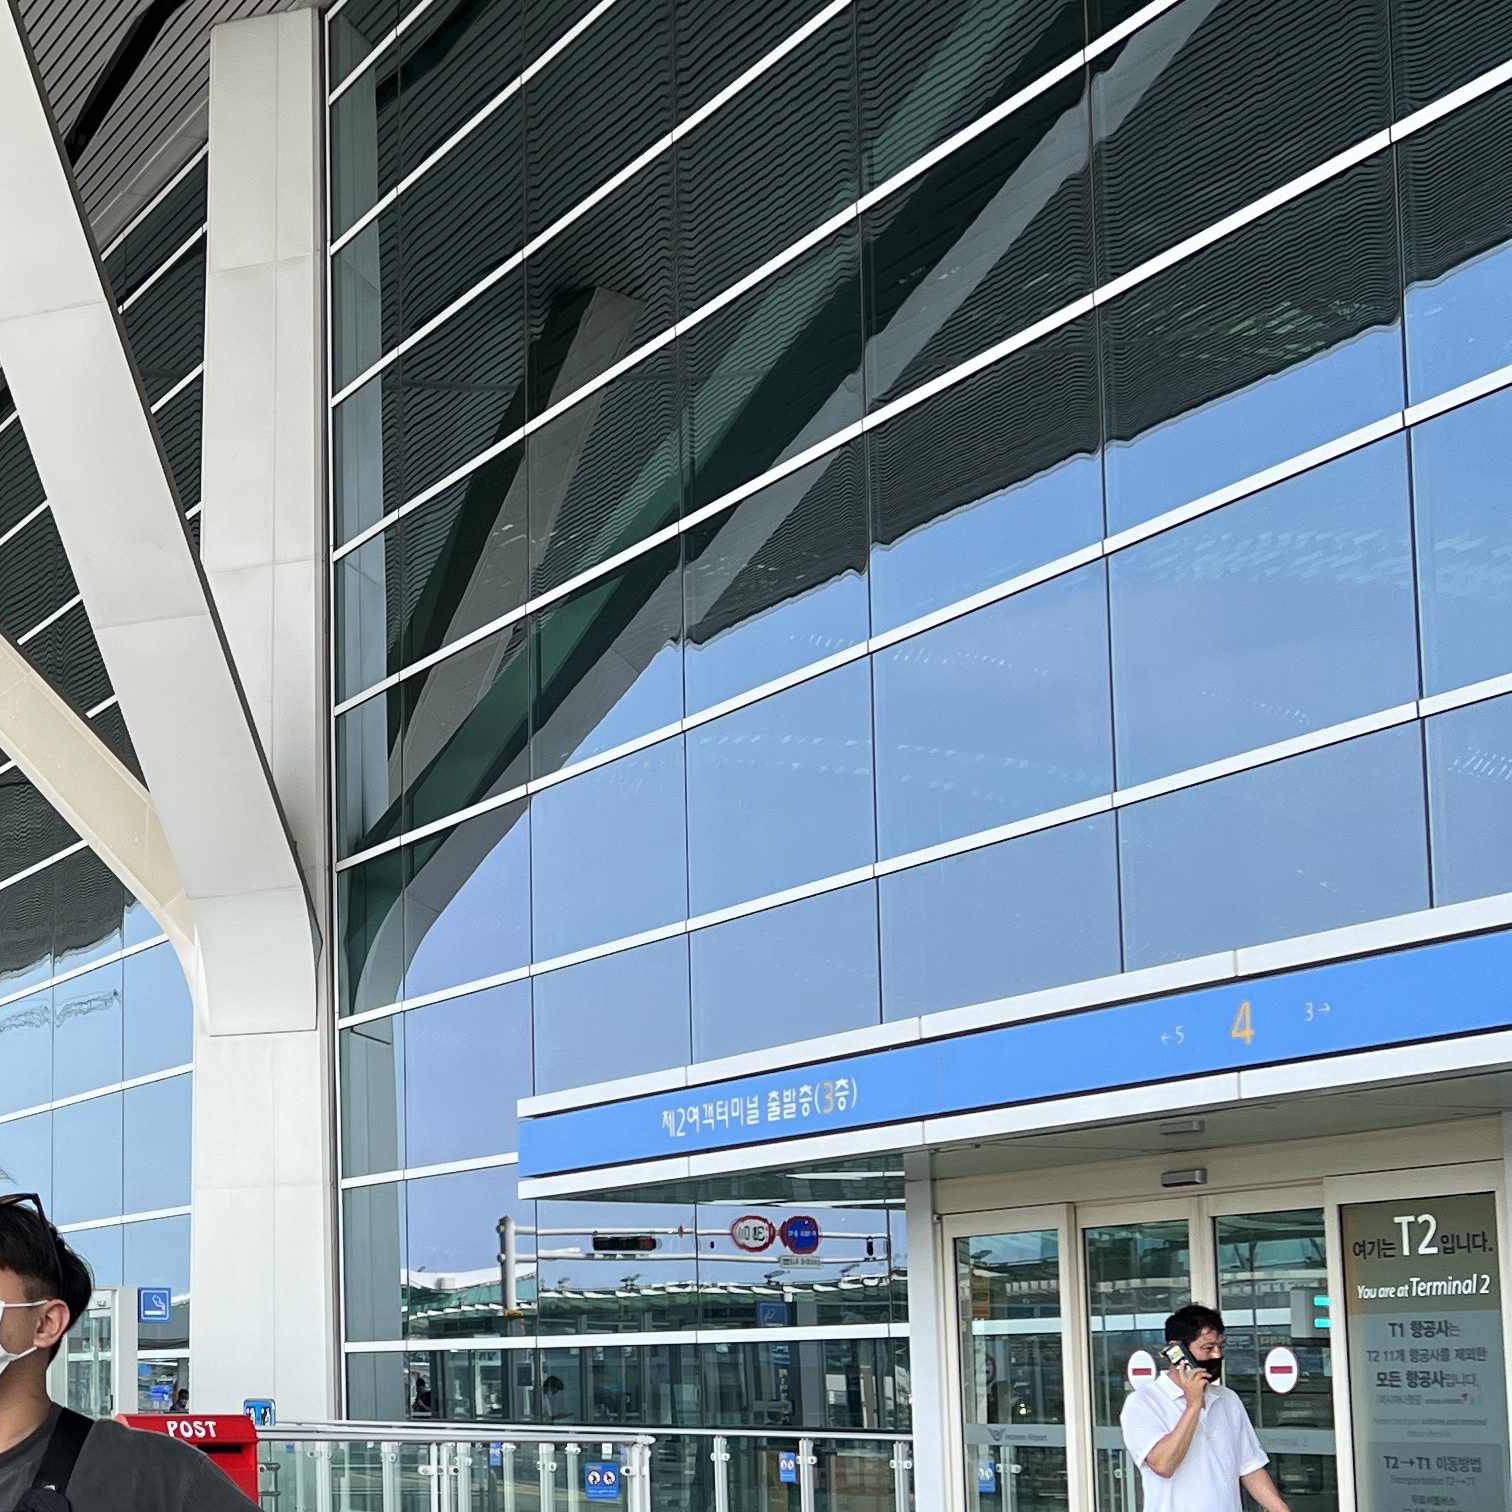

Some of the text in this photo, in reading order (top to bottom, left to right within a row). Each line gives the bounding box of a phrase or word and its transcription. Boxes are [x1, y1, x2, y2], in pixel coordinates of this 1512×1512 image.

[1231, 1000, 1255, 1044] 4
[1304, 1002, 1314, 1022] 3
[1175, 1024, 1185, 1044] 5
[661, 1077, 857, 1137] 제2여객터미널 출발층(3층)
[1352, 1213, 1494, 1260] 여기는 T2 입니다.
[1356, 1273, 1491, 1299] You are at Terminal 2
[1388, 1319, 1461, 1338] T1 항공사는
[1366, 1349, 1380, 1362] T2
[1383, 1348, 1406, 1362] 11개
[1376, 1371, 1402, 1388] 모든
[166, 1420, 217, 1438] POST
[1435, 1456, 1482, 1473] 이동방법
